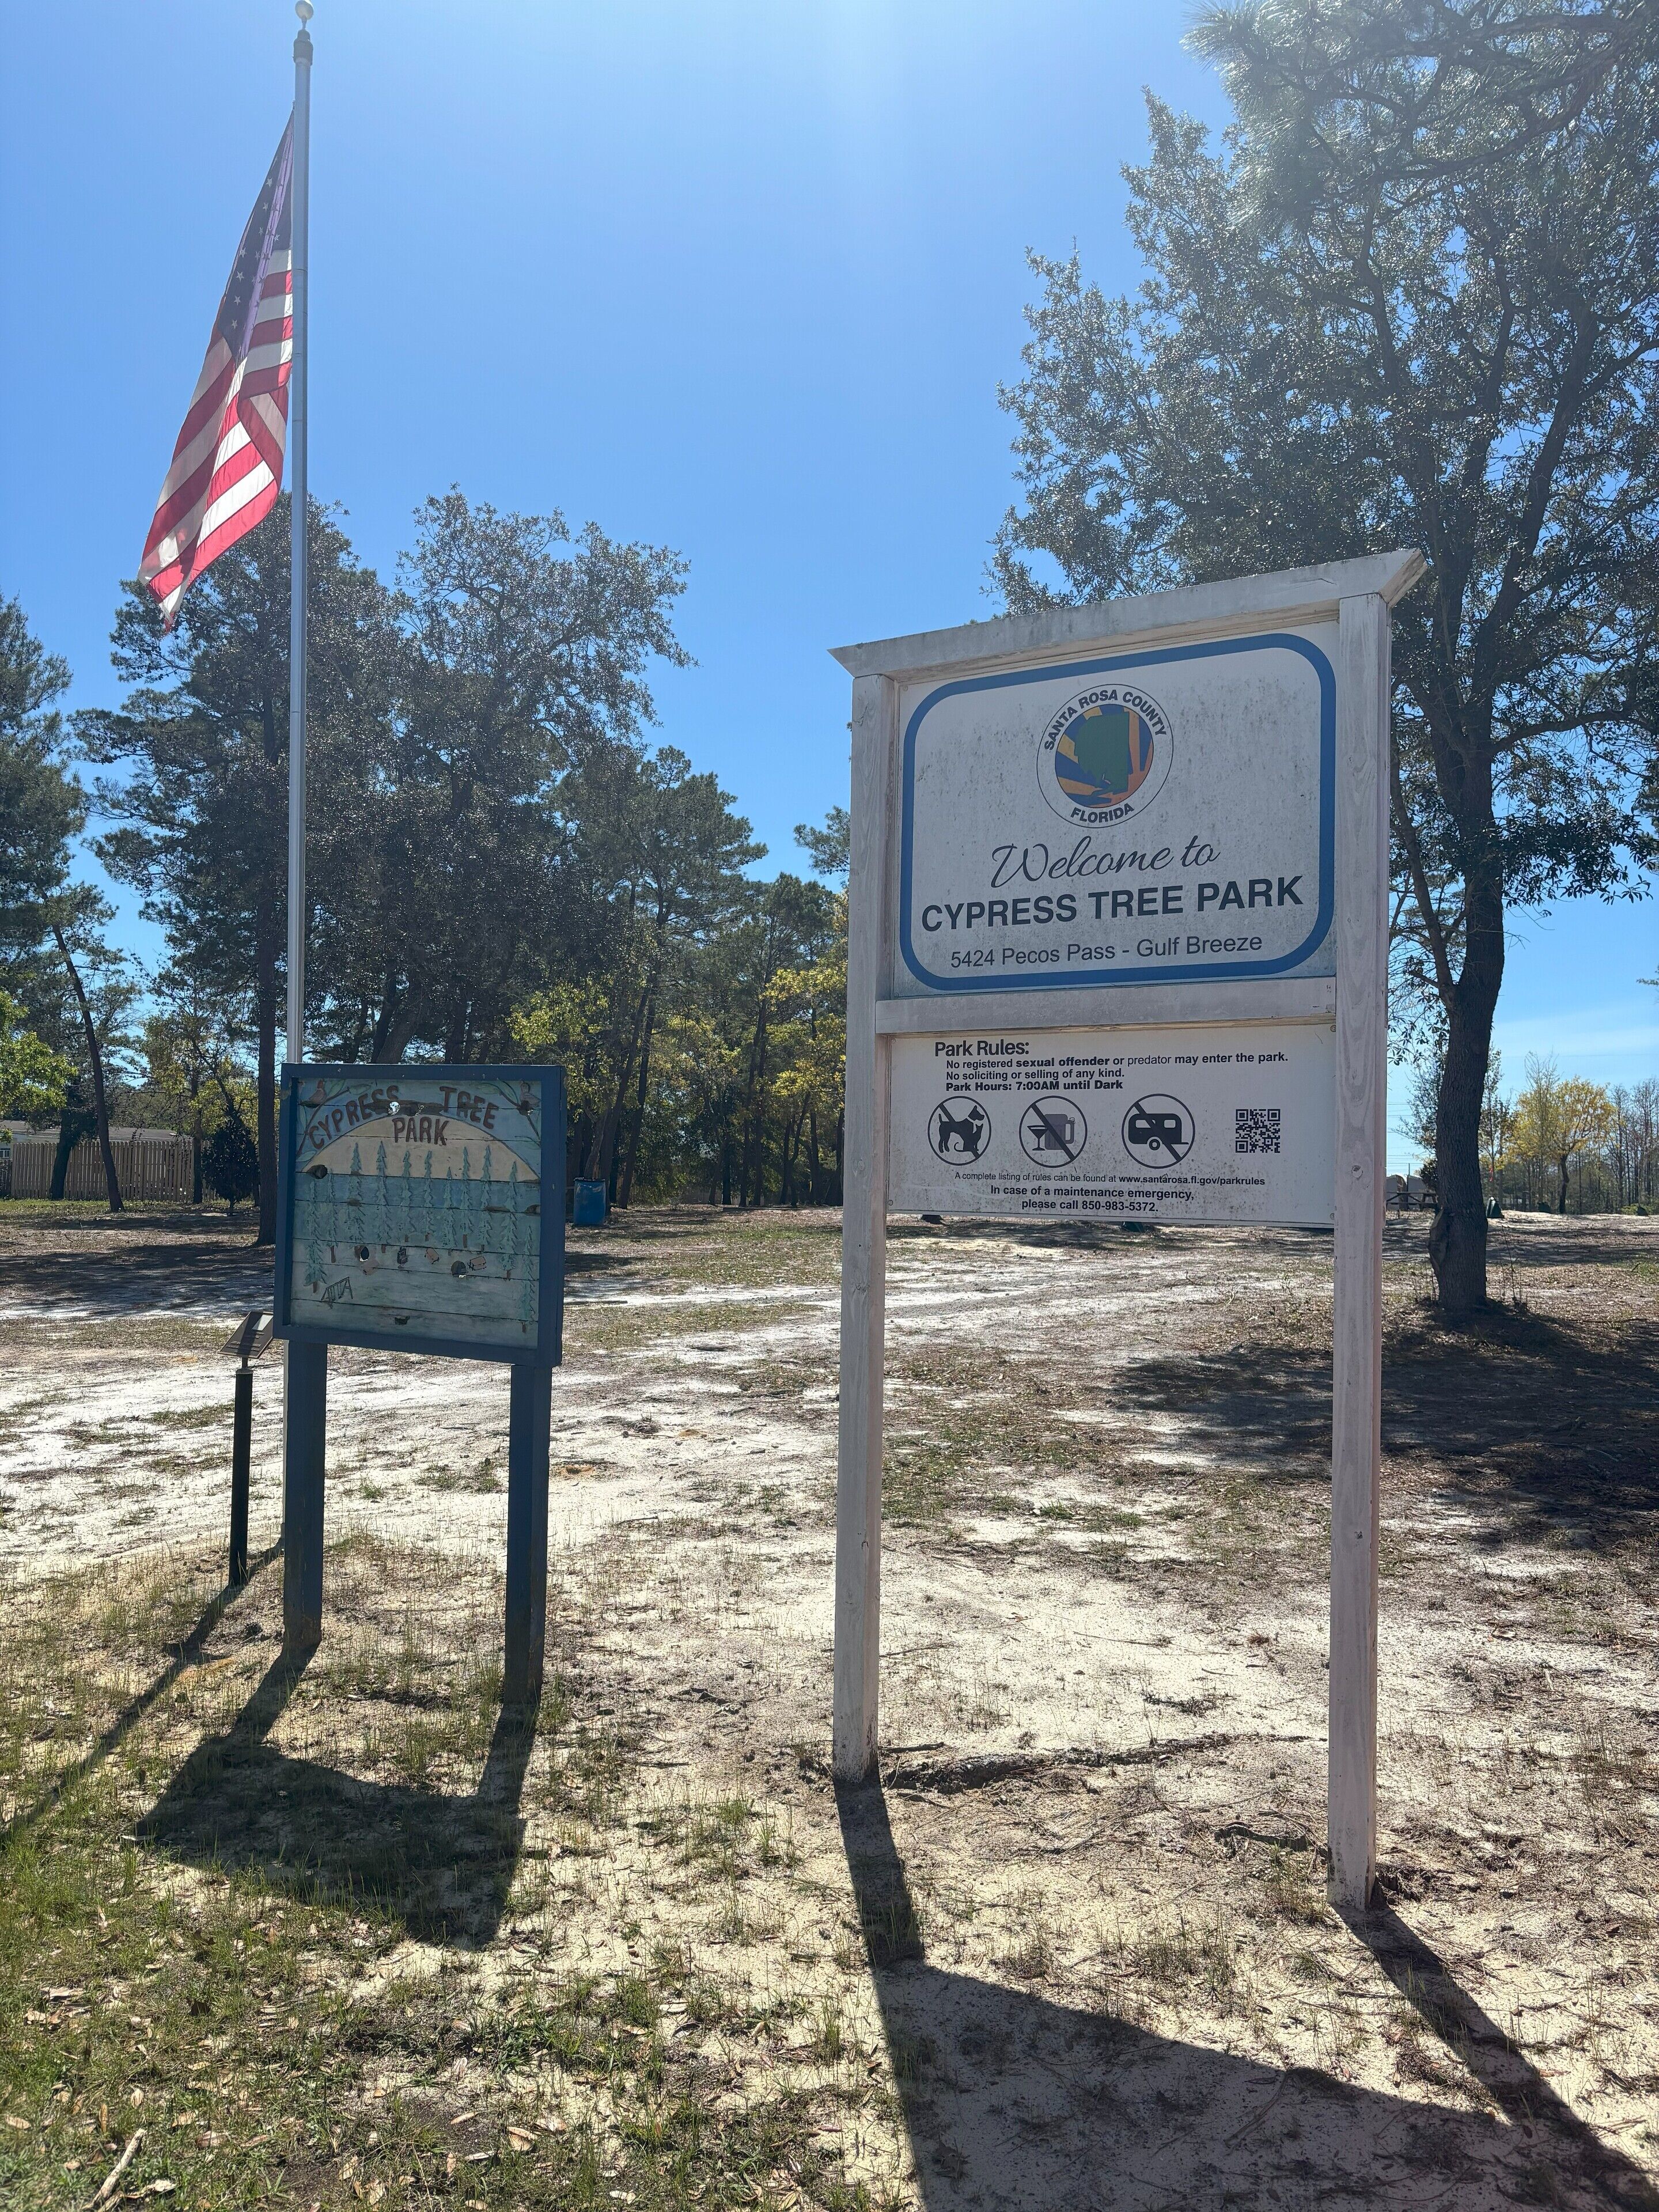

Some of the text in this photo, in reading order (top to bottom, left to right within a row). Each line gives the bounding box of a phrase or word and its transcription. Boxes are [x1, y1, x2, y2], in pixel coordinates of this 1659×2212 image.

[1044, 690, 1166, 751] SANTA ROSA COUNTY
[1070, 803, 1134, 823] FLORIDA
[991, 835, 1221, 888] Welcome to
[922, 875, 1304, 932] CYPRESS TREE PARK
[951, 949, 995, 968] 5424
[1002, 945, 1060, 965] Pecos
[1067, 941, 1116, 961] Pass
[1136, 937, 1179, 957] Gulf
[1186, 933, 1262, 954] Breeze
[935, 1039, 1029, 1056] Park Rules:
[946, 1060, 960, 1069] No
[963, 1059, 1012, 1069] registered
[1016, 1058, 1055, 1067] sexual
[1059, 1056, 1110, 1066] offender
[1128, 1055, 1171, 1067] predator
[1175, 1055, 1199, 1065] may
[1202, 1054, 1233, 1063] enter
[1236, 1052, 1254, 1062] the
[1259, 1052, 1288, 1063] park.
[946, 1071, 960, 1080] No
[963, 1071, 1007, 1081] soliciting
[1025, 1070, 1059, 1080] selling
[1062, 1069, 1073, 1078] of
[1075, 1070, 1094, 1080] any
[1099, 1069, 1124, 1077] kind.
[946, 1080, 1123, 1091] Park Hours: 7:00AM until Dark
[439, 1086, 499, 1130] TREE
[392, 1117, 449, 1146] PARK
[962, 1173, 996, 1181] complete
[998, 1173, 1020, 1181] listing
[1119, 1176, 1265, 1185] www.santarosa.fl.gov/parkrules
[991, 1185, 999, 1194] In
[1003, 1187, 1027, 1195] case
[1031, 1186, 1041, 1195] of
[1054, 1187, 1124, 1197] maintenance
[1127, 1190, 1194, 1201] emergency,
[1022, 1199, 1158, 1212] please call 850-983-5372.
